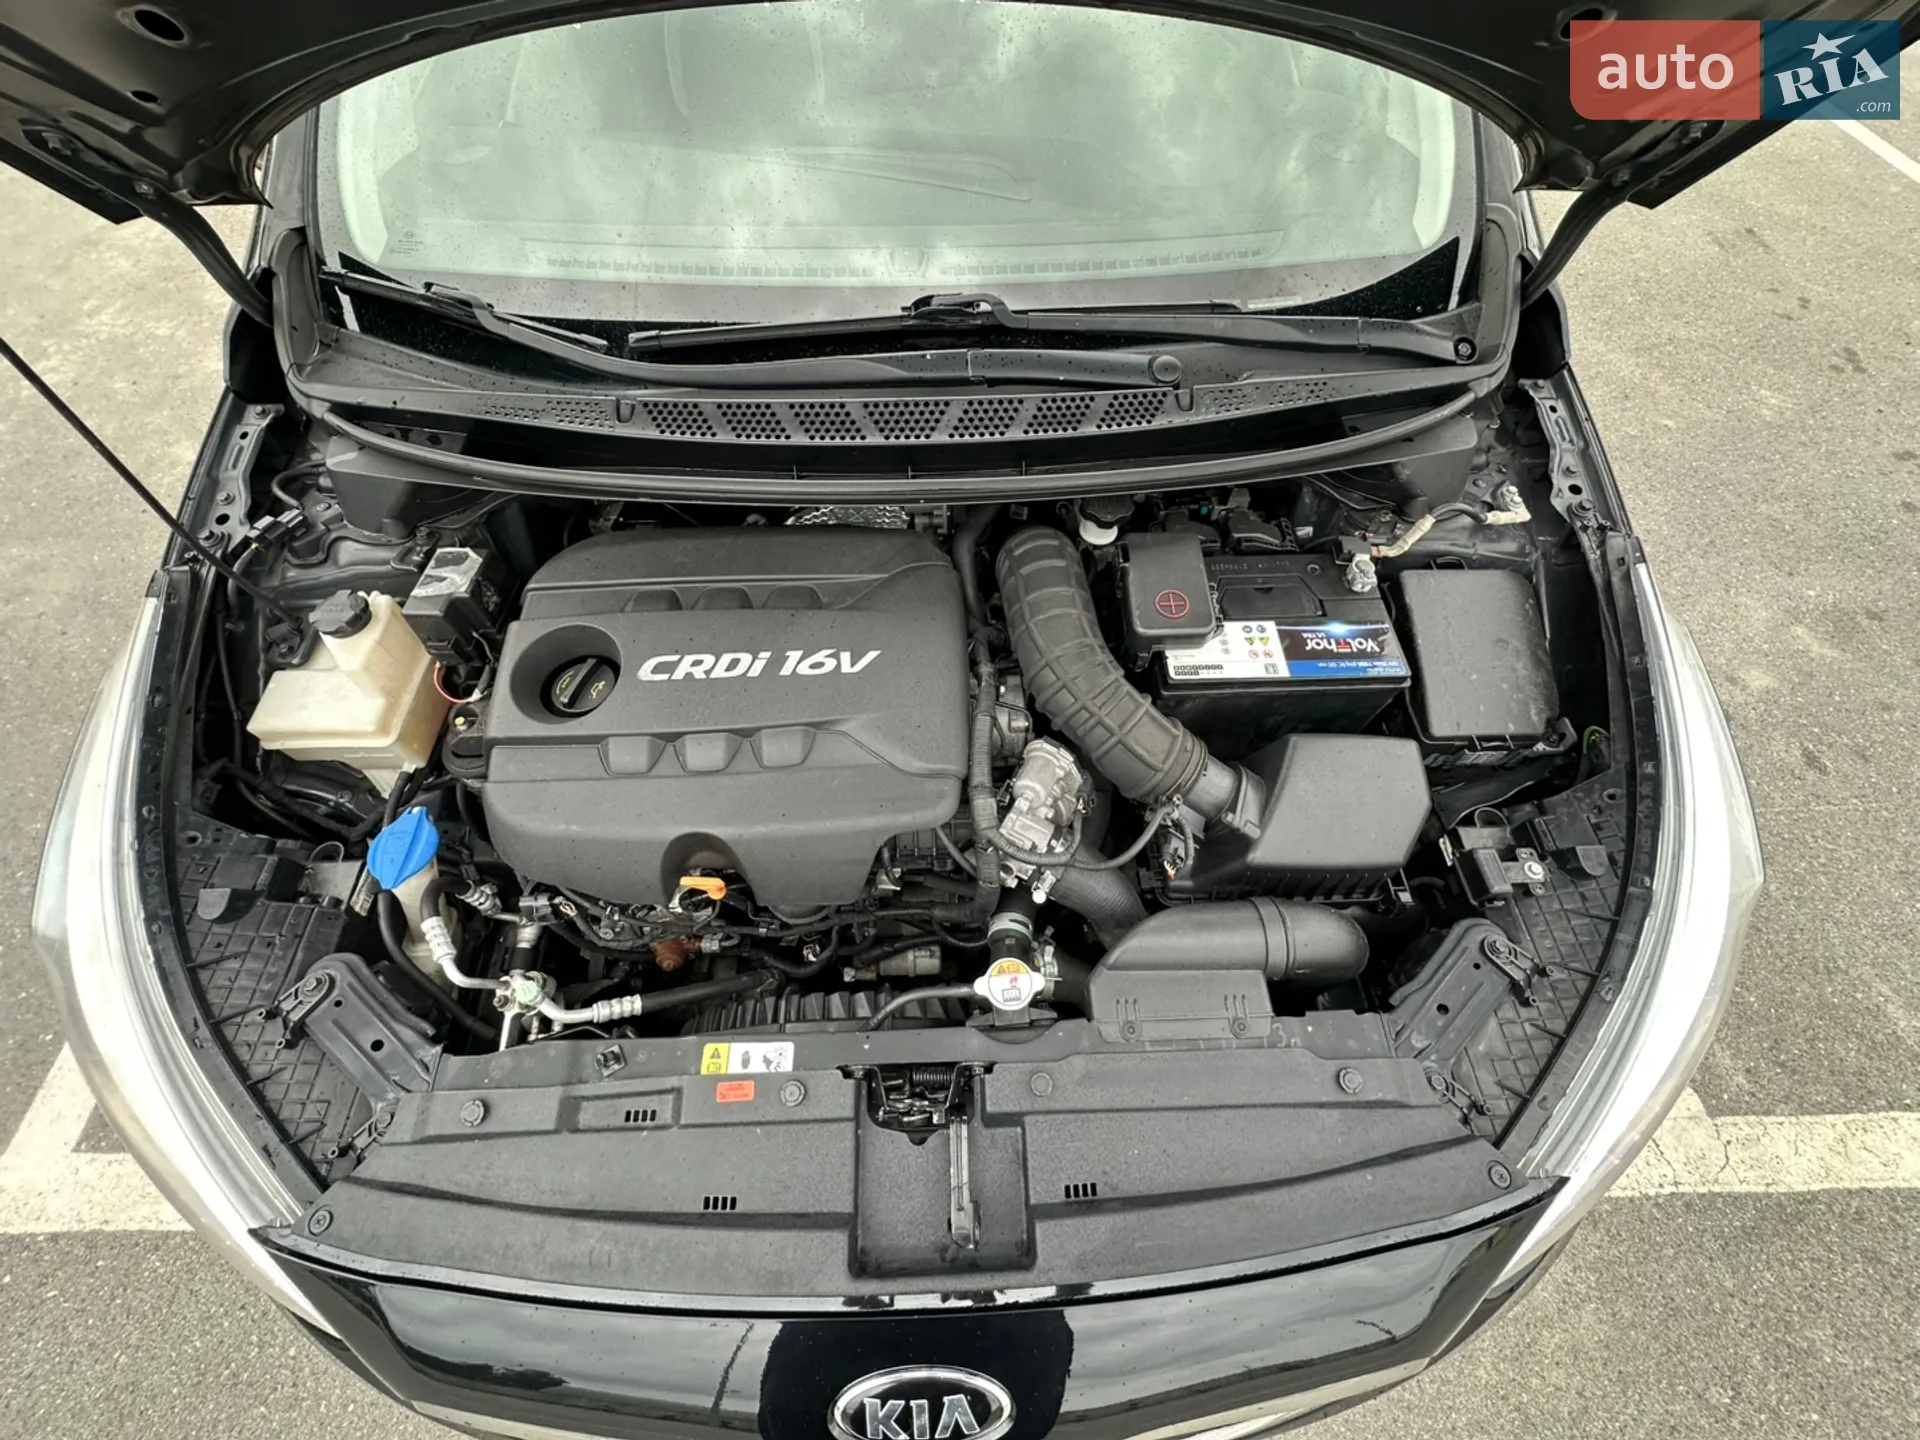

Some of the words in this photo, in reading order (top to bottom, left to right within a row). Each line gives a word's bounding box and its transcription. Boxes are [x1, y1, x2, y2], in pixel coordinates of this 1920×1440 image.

[637, 651, 771, 681] CRDi
[778, 648, 882, 676] 16V
[863, 1394, 980, 1440] KIA
